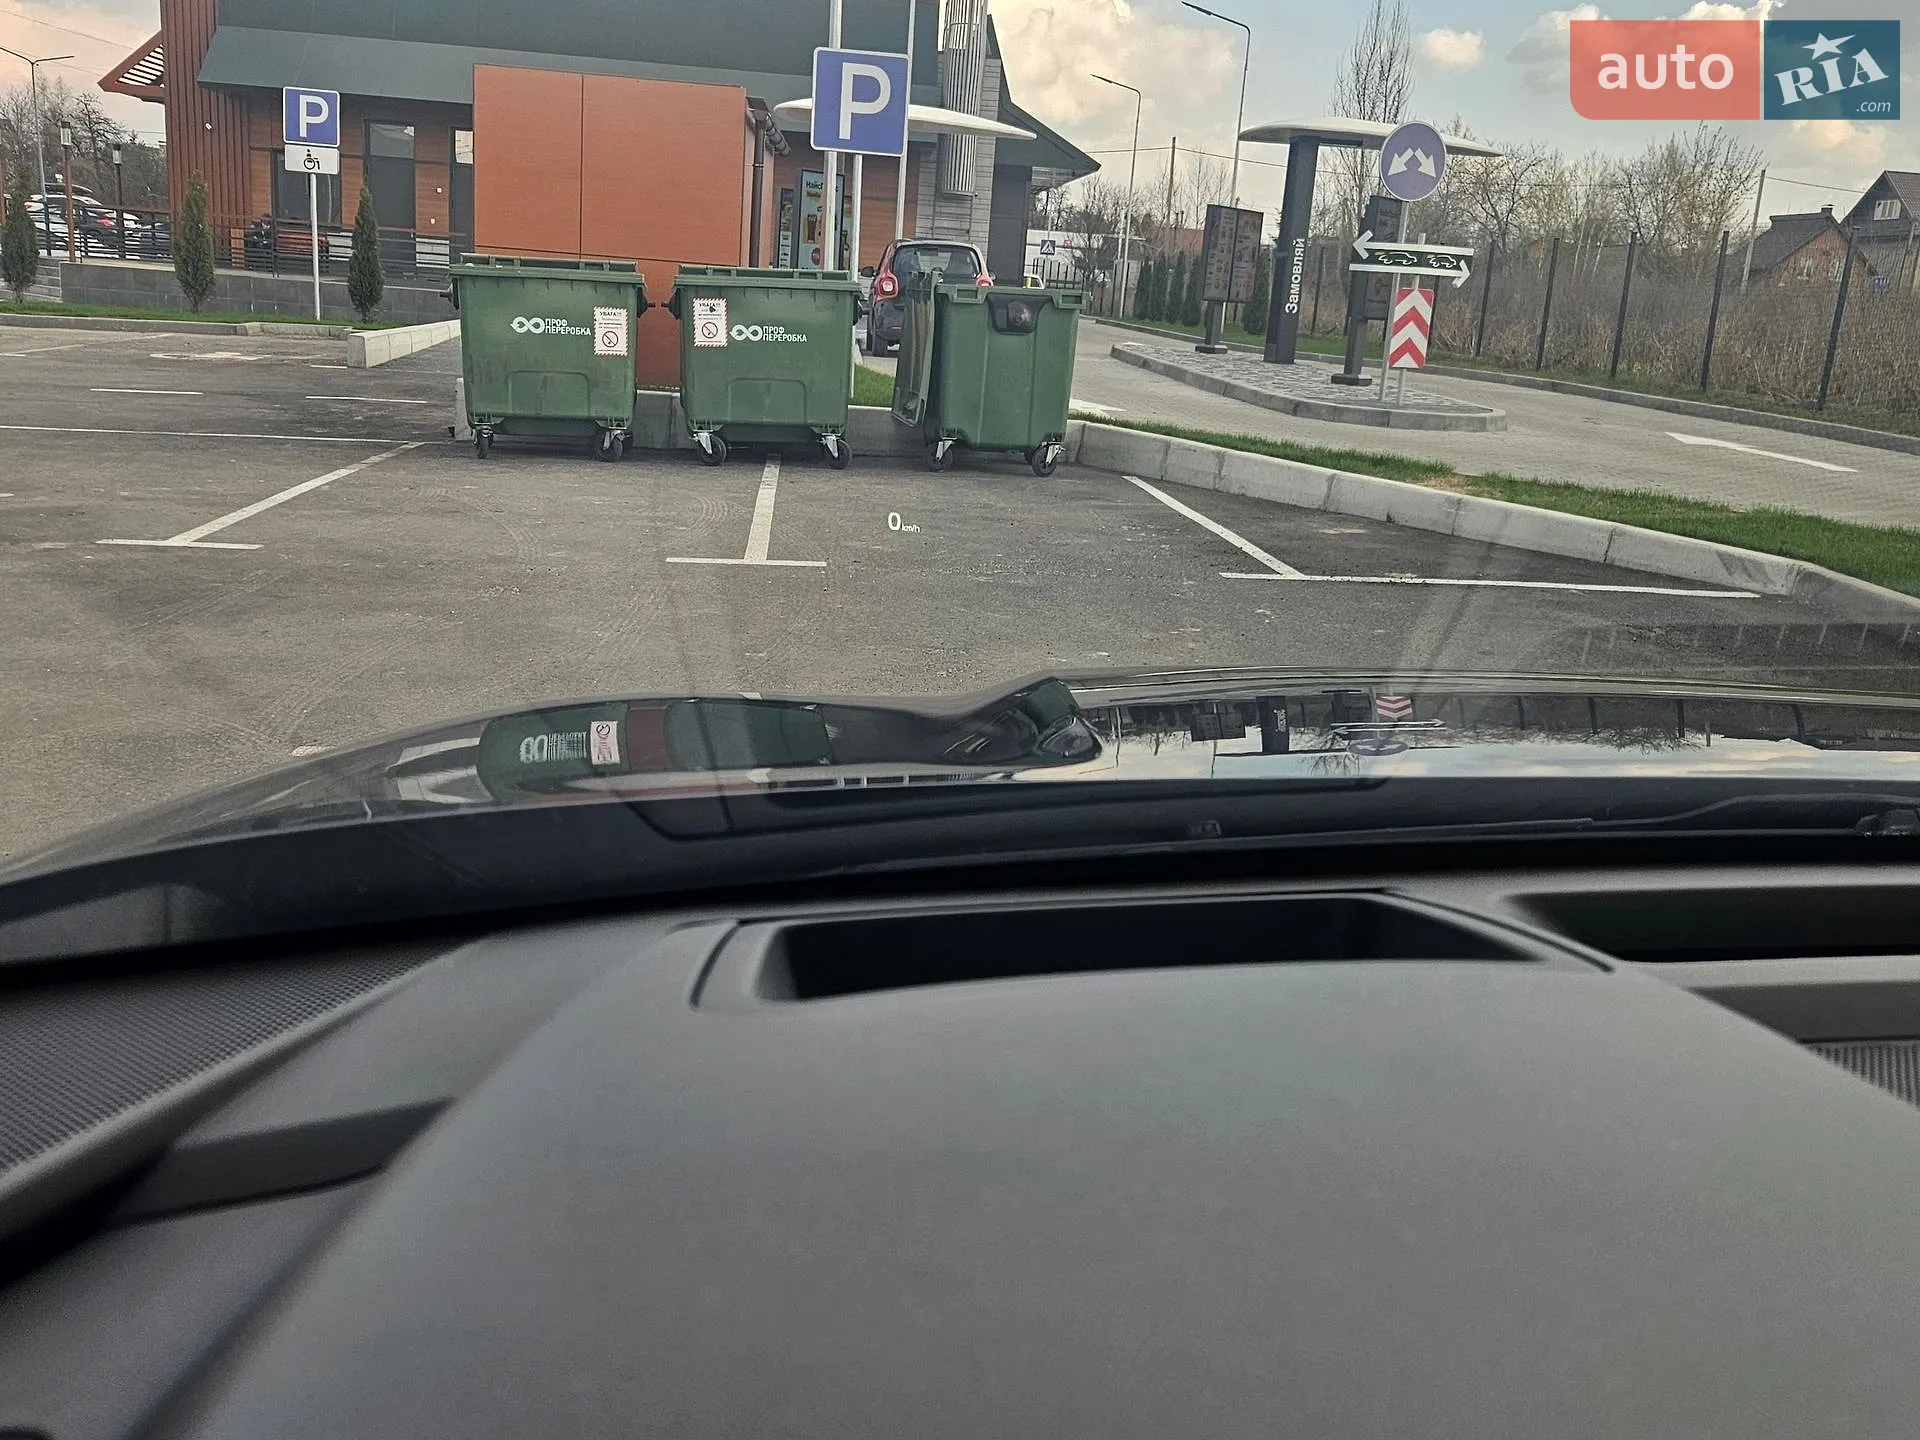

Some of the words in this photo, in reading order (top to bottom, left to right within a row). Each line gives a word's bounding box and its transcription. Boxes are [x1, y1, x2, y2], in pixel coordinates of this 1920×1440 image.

[838, 62, 891, 140] P
[299, 94, 329, 138] P
[1285, 238, 1306, 314] Замовляй
[545, 318, 568, 327] ПРОФ
[762, 326, 785, 334] ПРОФ
[545, 326, 592, 336] ПЕРЕРОБКА
[762, 333, 808, 342] ПЕРЕРОБКА
[888, 511, 901, 531] 0
